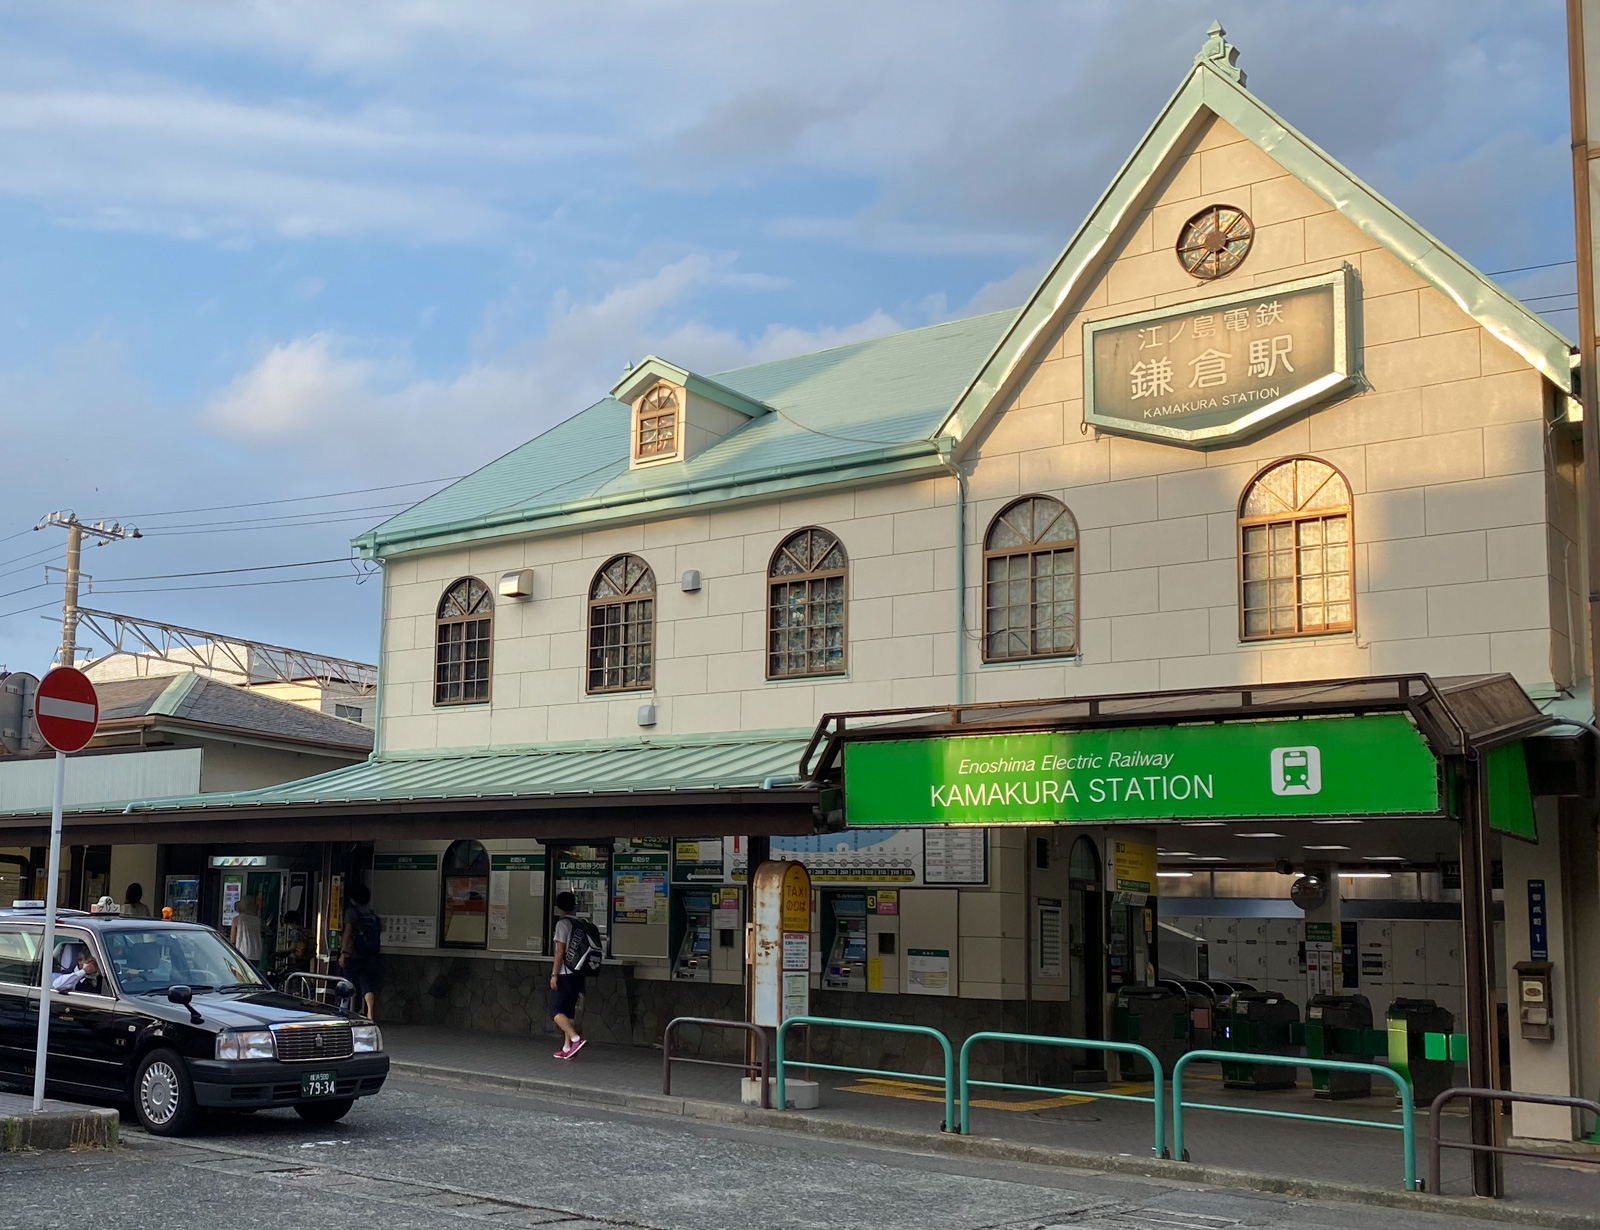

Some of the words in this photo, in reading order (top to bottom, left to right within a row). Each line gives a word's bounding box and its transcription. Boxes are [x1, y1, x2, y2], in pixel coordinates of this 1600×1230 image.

[1137, 300, 1284, 351] 江ノ島電鉄
[1129, 334, 1295, 401] 鎌倉駅
[1143, 399, 1218, 419] KAMAKURA
[1222, 386, 1281, 406] STATION
[958, 756, 1036, 775] Enoshima
[1041, 754, 1103, 772] Electric
[1108, 751, 1174, 771] Railway
[930, 781, 1079, 807] KAMAKURA
[1088, 774, 1214, 802] STATION
[713, 894, 718, 903] 1
[786, 885, 807, 898] TAXI
[786, 901, 807, 912] のりば
[869, 897, 875, 907] 3
[309, 1080, 335, 1095] 79-34
